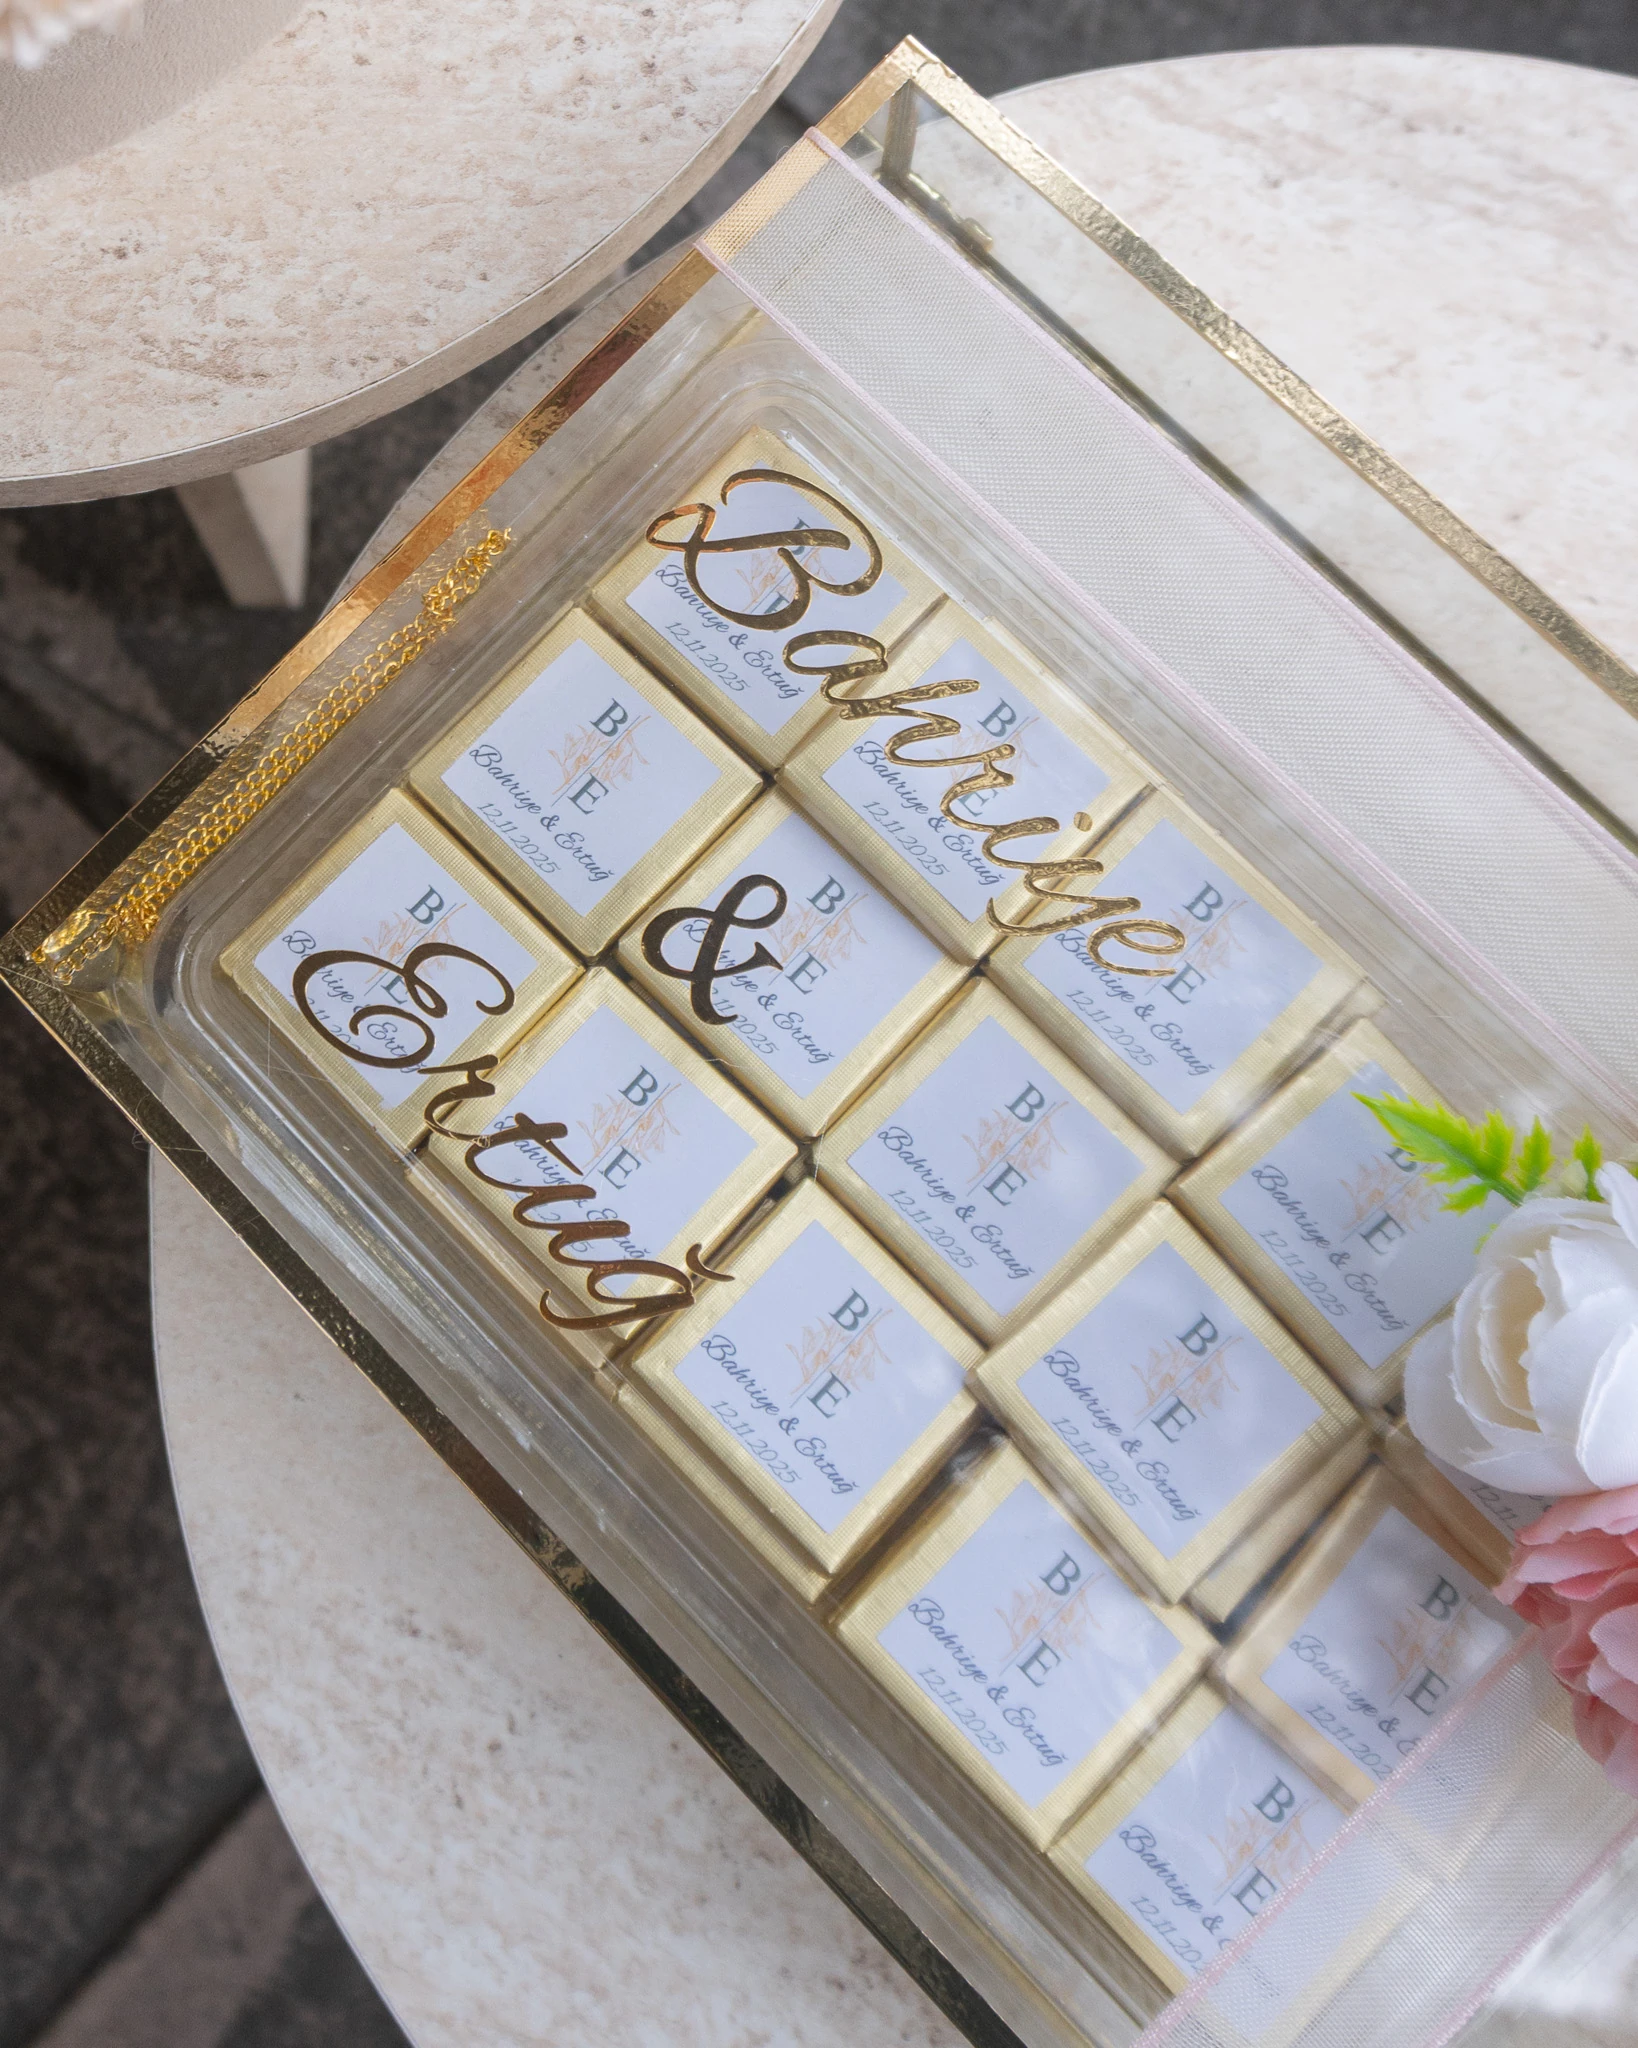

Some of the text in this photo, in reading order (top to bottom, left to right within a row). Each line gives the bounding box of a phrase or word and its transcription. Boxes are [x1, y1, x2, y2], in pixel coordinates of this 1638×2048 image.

[664, 621, 751, 692] 12.11.2025
[728, 633, 749, 651] &
[743, 649, 805, 699] Ertuğ
[588, 697, 629, 737] B
[645, 467, 1188, 978] Bahriye
[977, 697, 1017, 738] B
[468, 743, 615, 882] Bahriye & Ertuğ
[567, 772, 609, 815] E
[853, 740, 1007, 886] Bahriye & Ertuğ
[476, 802, 562, 874] 12.11.2025
[862, 800, 951, 876] 12.11.2025
[404, 884, 445, 926] B
[807, 874, 846, 915] B
[1182, 880, 1225, 923] B
[640, 873, 788, 1026] &
[785, 951, 828, 995] E
[1161, 959, 1208, 1006] E
[757, 993, 778, 1012] &
[772, 1011, 836, 1065] Ertuğ
[1065, 989, 1160, 1067] 12.11.2025
[1133, 1003, 1156, 1023] &
[1149, 1021, 1217, 1077] Ertuğ
[617, 1064, 659, 1107] B
[1004, 1080, 1046, 1124] B
[291, 941, 736, 1331] Ertuğ
[598, 1145, 642, 1190] E
[877, 1126, 1036, 1280] Bahriye & Ertuğ
[982, 1160, 1029, 1207] E
[887, 1188, 980, 1270] 12.11.2025
[1250, 1163, 1411, 1333] Bahriye & Ertuğ
[1359, 1210, 1407, 1256] E
[1257, 1227, 1352, 1320] 12.11.2025
[828, 1287, 870, 1332] B
[1175, 1311, 1219, 1358] B
[700, 1333, 861, 1495] Bahriye & Ertuğ
[805, 1370, 852, 1420] E
[1150, 1393, 1198, 1444] E
[709, 1399, 803, 1485] 12.11.2025
[1043, 1349, 1202, 1522] Bahriye & Ertuğ
[1051, 1416, 1144, 1508] 12.11.2025
[1038, 1549, 1082, 1597] B
[1417, 1573, 1460, 1622] B
[907, 1597, 1070, 1768] Bahriye & Ertuğ
[1015, 1637, 1062, 1689] E
[1287, 1634, 1401, 1739] Bahriye &
[1405, 1667, 1450, 1718] E
[916, 1666, 1011, 1756] 12.11.2025
[1304, 1703, 1395, 1782] 12.11.202
[1253, 1776, 1296, 1824] B
[1118, 1823, 1226, 1936] Bahriye &
[1231, 1866, 1278, 1918] E
[1129, 1895, 1205, 1974] 12.11.20
